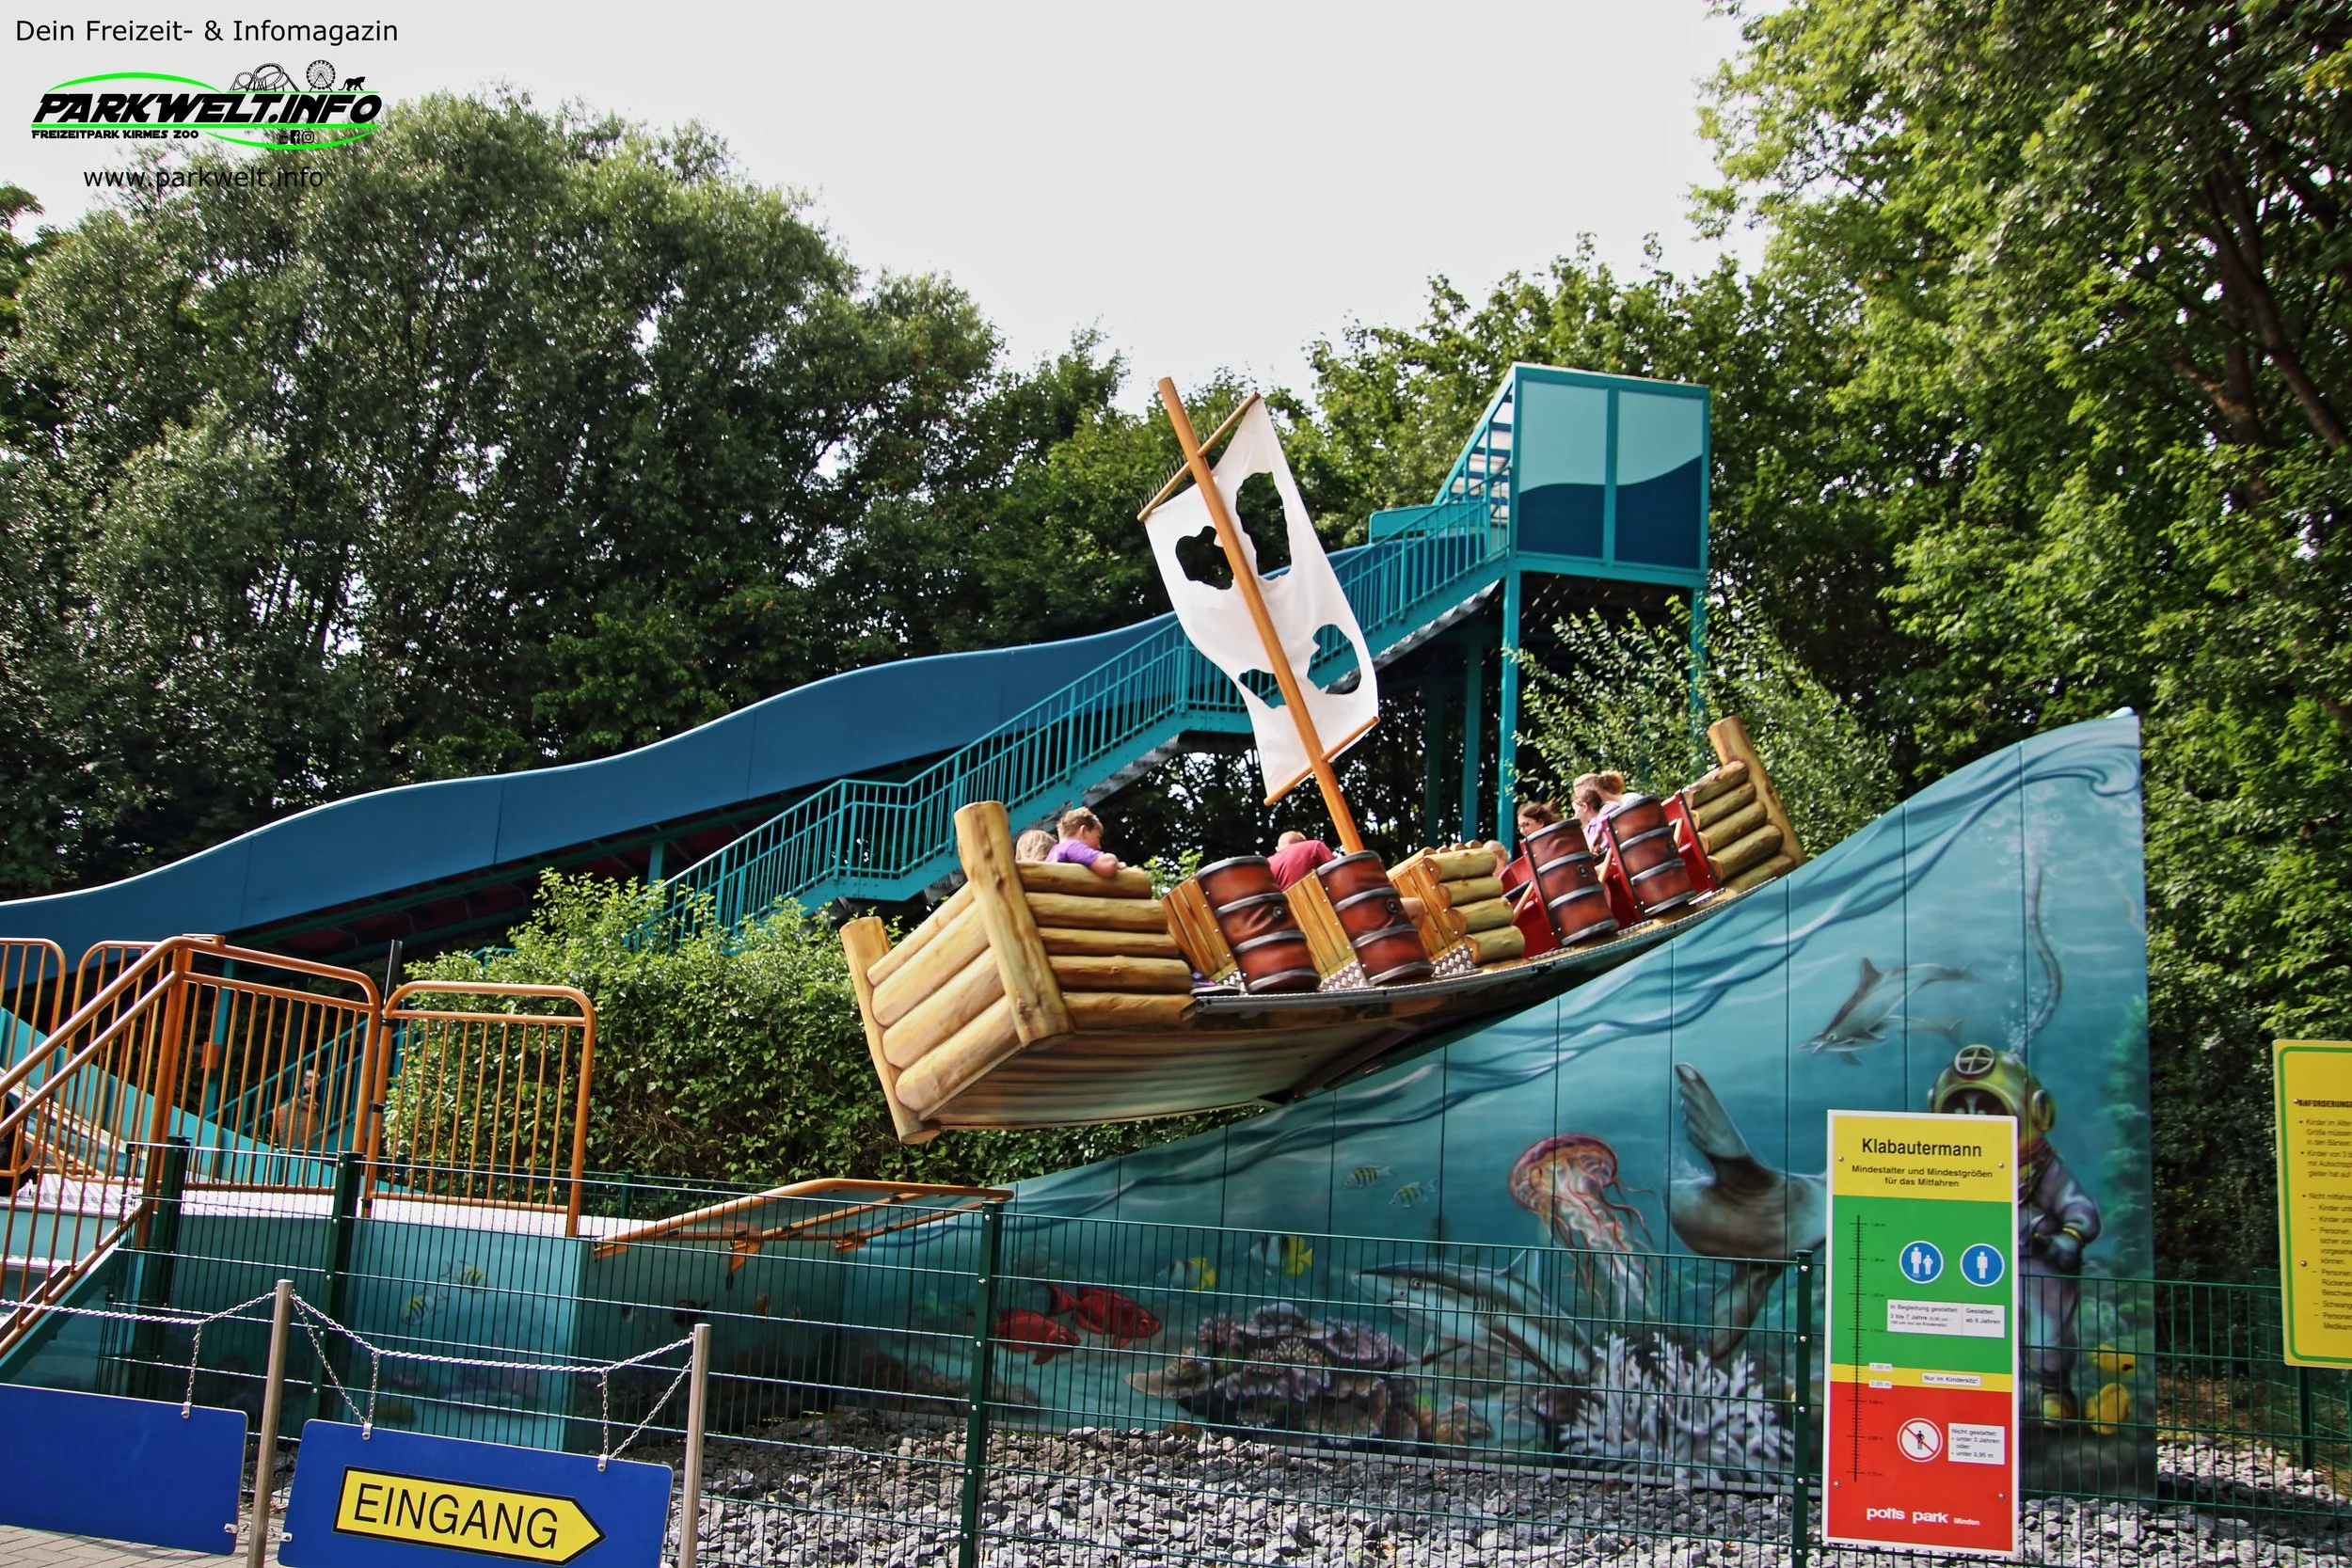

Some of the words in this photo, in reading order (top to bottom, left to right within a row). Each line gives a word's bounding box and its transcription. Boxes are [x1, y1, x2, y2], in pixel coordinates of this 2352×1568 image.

[1862, 1137, 1982, 1158] Klabautermann
[1851, 1165, 1905, 1175] Mindestalter
[1927, 1168, 1994, 1179] Mindestgrößen
[1918, 1178, 1960, 1187] Mitfahren
[354, 1483, 558, 1549] EINGANG
[1913, 1511, 1948, 1524] park
[1953, 1517, 1980, 1526] Minden
